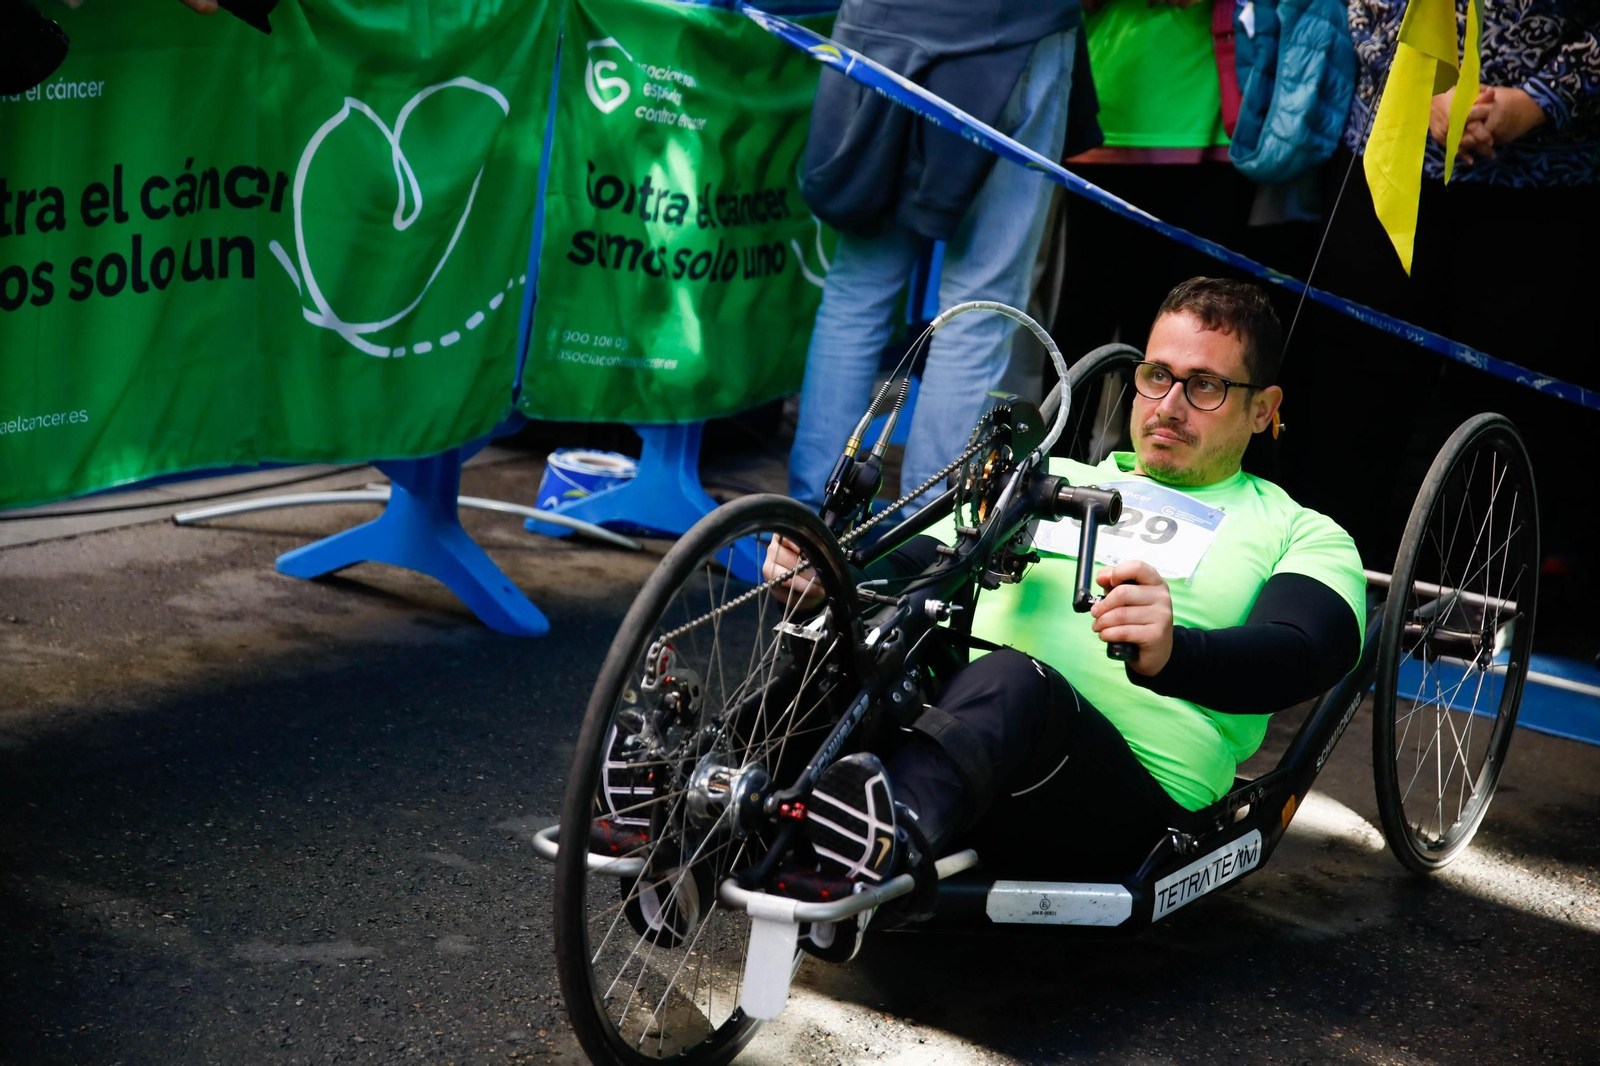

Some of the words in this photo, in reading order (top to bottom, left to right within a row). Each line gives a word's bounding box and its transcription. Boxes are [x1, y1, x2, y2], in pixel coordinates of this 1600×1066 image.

[46, 77, 105, 100] cáncer
[80, 164, 129, 228] el
[586, 159, 690, 226] otra
[69, 233, 176, 302] solo
[672, 238, 738, 283] solo
[743, 240, 787, 281] uno
[1071, 507, 1179, 545] 29
